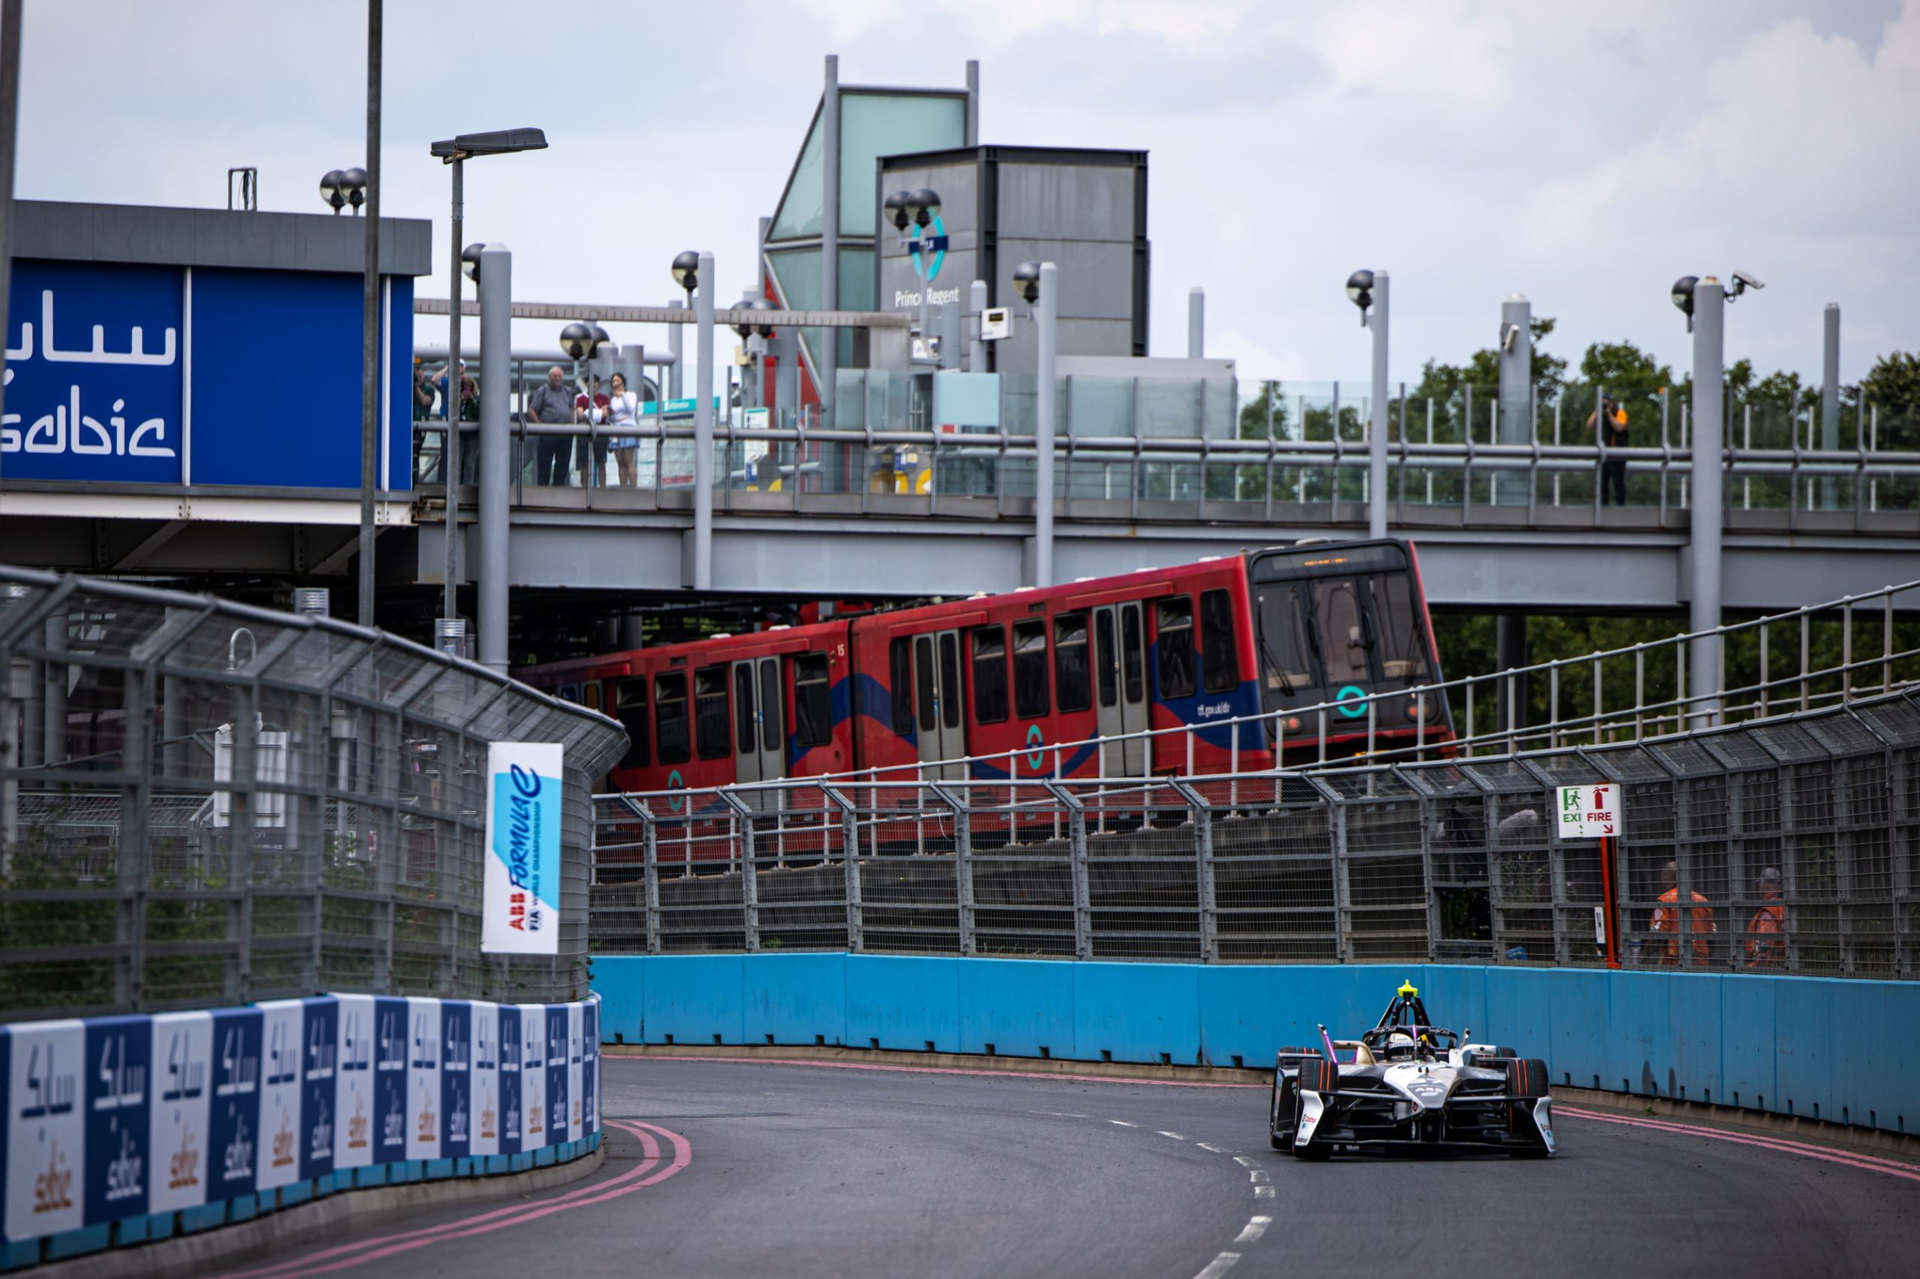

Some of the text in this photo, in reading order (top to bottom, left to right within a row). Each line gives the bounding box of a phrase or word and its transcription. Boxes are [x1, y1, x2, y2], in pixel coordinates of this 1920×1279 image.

[927, 287, 960, 306] Regent
[4, 290, 177, 386] ساب
[1, 384, 176, 458] sabic
[508, 795, 531, 890] FORMULA
[1563, 812, 1612, 823] EXI FIRE
[529, 800, 542, 931] FIA WORLD CHAMPIONSHIP
[509, 892, 525, 931] ABB
